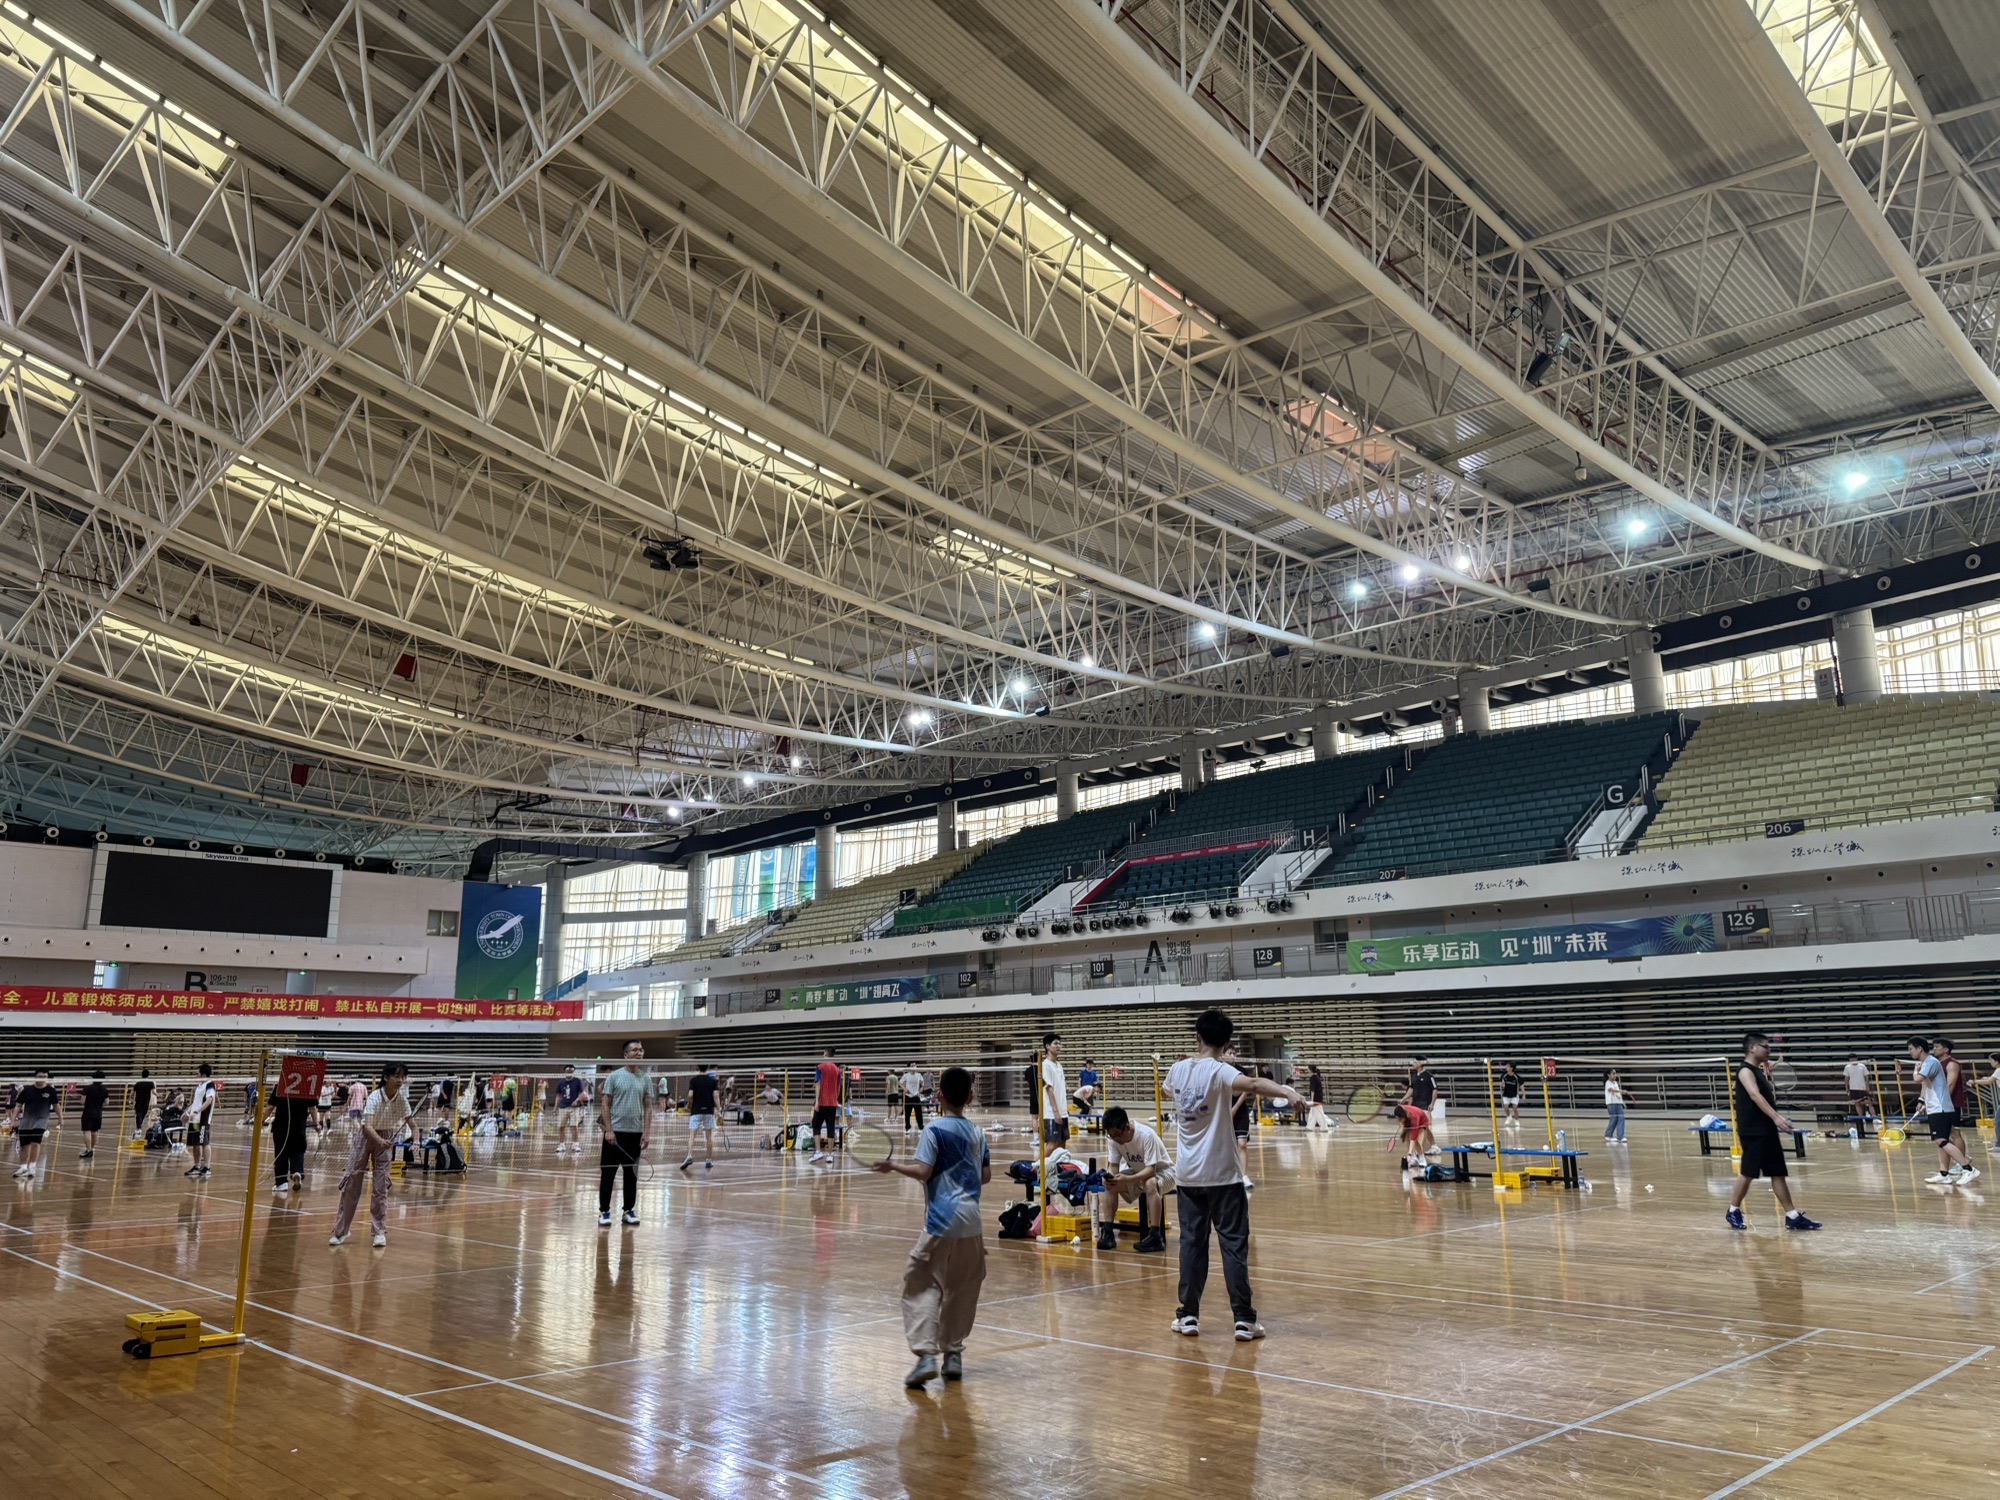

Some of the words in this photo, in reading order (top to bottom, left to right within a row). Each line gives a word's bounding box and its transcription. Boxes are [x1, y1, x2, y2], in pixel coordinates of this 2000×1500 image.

[1607, 785, 1624, 803] G
[1766, 823, 1791, 835] 206
[1303, 829, 1315, 846] H
[205, 853, 237, 861] Skyworth
[1066, 866, 1072, 879] I
[1379, 870, 1396, 880] 207
[902, 891, 907, 904] J
[1118, 901, 1129, 909] 201
[769, 911, 775, 922] K
[1727, 912, 1755, 927] 126
[1166, 941, 1191, 949] 101-105
[1144, 940, 1167, 974] A
[1167, 948, 1191, 956] 125-128
[1255, 949, 1273, 960] 128
[1403, 941, 1480, 963] 乐享运动
[1092, 962, 1104, 972] 101
[210, 974, 237, 982] 106-110
[960, 973, 971, 982] 102
[767, 990, 776, 998] 104
[0, 990, 562, 1017] 全，儿童锻炼须成人陪同。严禁嬉戏打闹，禁止私自开展一切培训、比赛等活动。
[1547, 1066, 1556, 1077] 23
[285, 1072, 318, 1096] 21
[492, 1080, 503, 1088] 17
[1126, 1151, 1143, 1163] Lee
